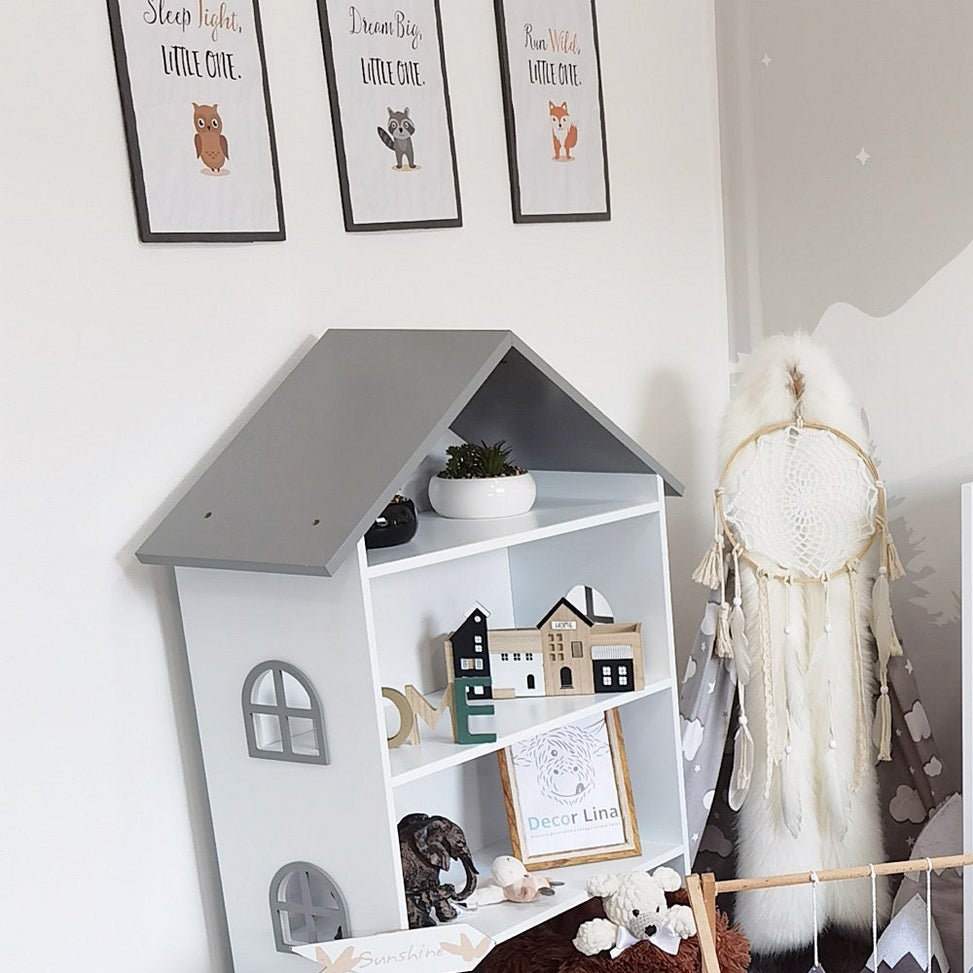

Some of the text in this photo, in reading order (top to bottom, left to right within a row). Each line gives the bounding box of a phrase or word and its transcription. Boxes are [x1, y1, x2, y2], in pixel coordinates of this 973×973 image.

[143, 0, 192, 33] Sleep
[349, 6, 422, 50] Dream Big,
[523, 23, 581, 55] Run Wild,
[161, 45, 242, 80] LITTLE ONE.
[360, 57, 425, 87] LITTLE ONE.
[528, 59, 582, 87] LITTLE ONE.
[528, 812, 578, 831] Decor
[583, 806, 619, 822] Lina
[360, 944, 445, 968] Sunshine
